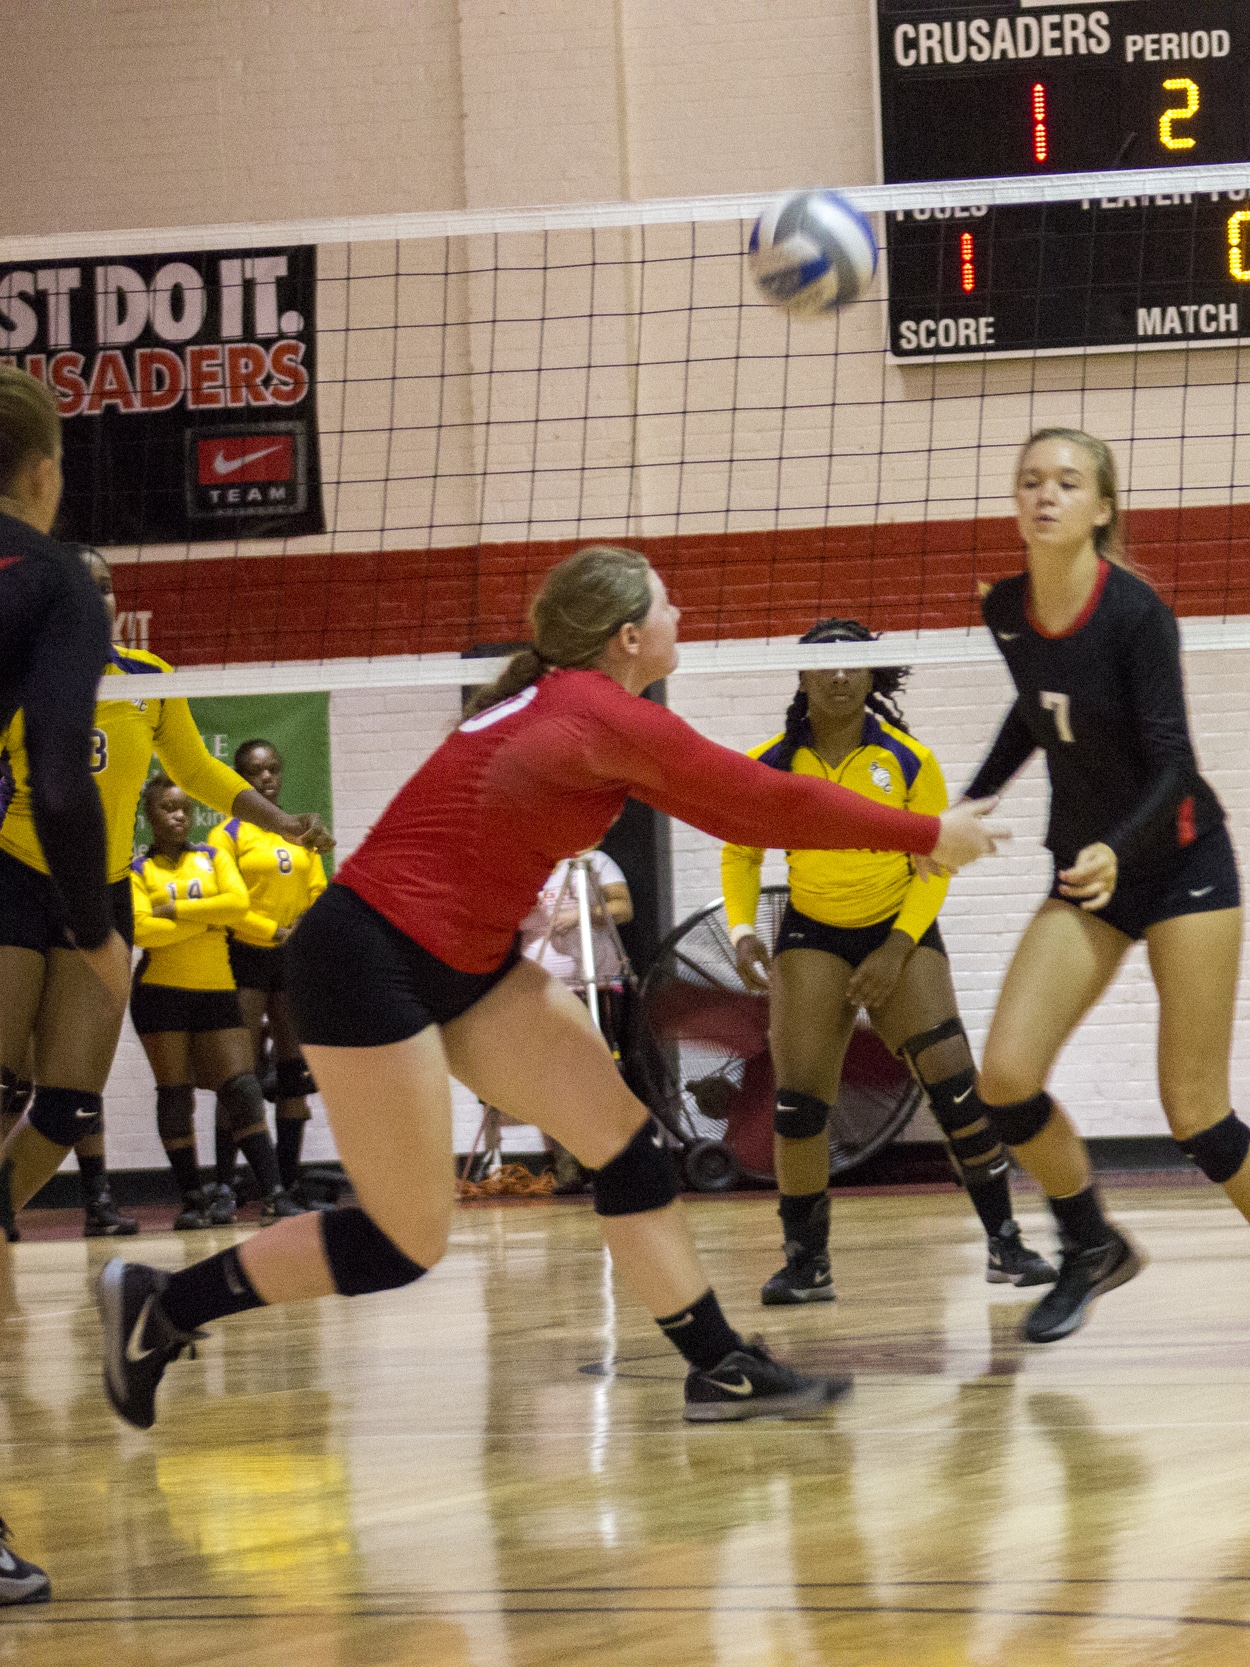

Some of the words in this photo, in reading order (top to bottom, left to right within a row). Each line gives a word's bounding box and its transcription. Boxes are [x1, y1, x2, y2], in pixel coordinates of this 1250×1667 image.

[894, 11, 1111, 67] CRUSADERS
[1125, 30, 1231, 62] PERIOD
[1032, 82, 1047, 163] 1
[1158, 78, 1200, 150] 2
[960, 231, 975, 293] 1
[95, 261, 207, 346] DO
[219, 255, 305, 340] IT.
[1137, 302, 1239, 336] MATCH
[900, 317, 995, 350] SCORE
[209, 487, 286, 503] TEAM
[1039, 690, 1076, 743] 7
[275, 847, 293, 876] 8
